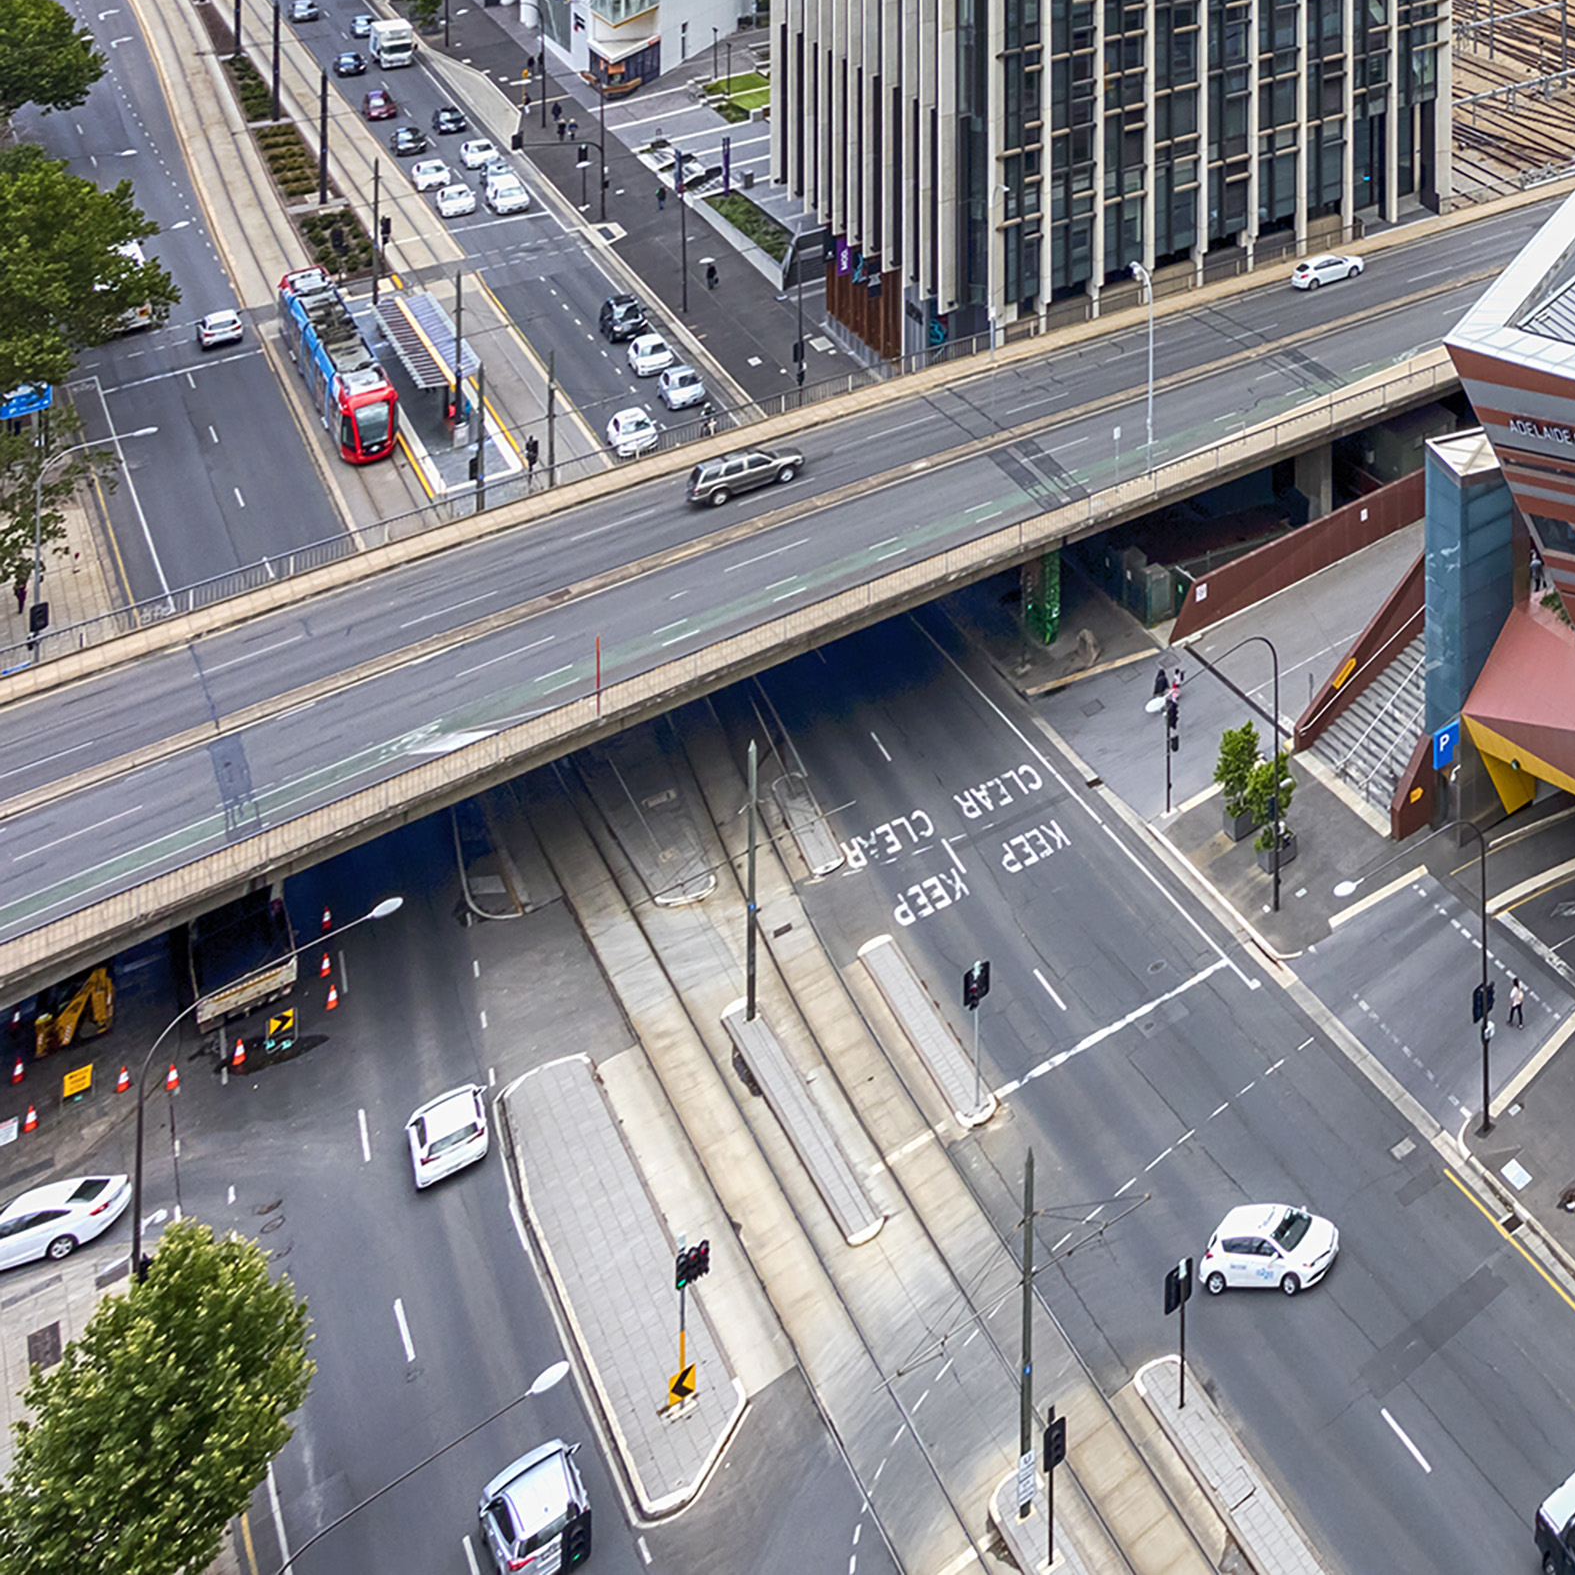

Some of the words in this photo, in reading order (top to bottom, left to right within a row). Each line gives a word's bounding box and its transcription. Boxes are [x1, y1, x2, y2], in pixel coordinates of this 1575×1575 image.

[1509, 419, 1572, 445] ADELAIDE
[1440, 733, 1450, 752] P
[953, 764, 1043, 819] CLEAR
[840, 809, 935, 869] CLEAR
[1002, 819, 1072, 873] KEEP
[894, 868, 970, 926] KEEP
